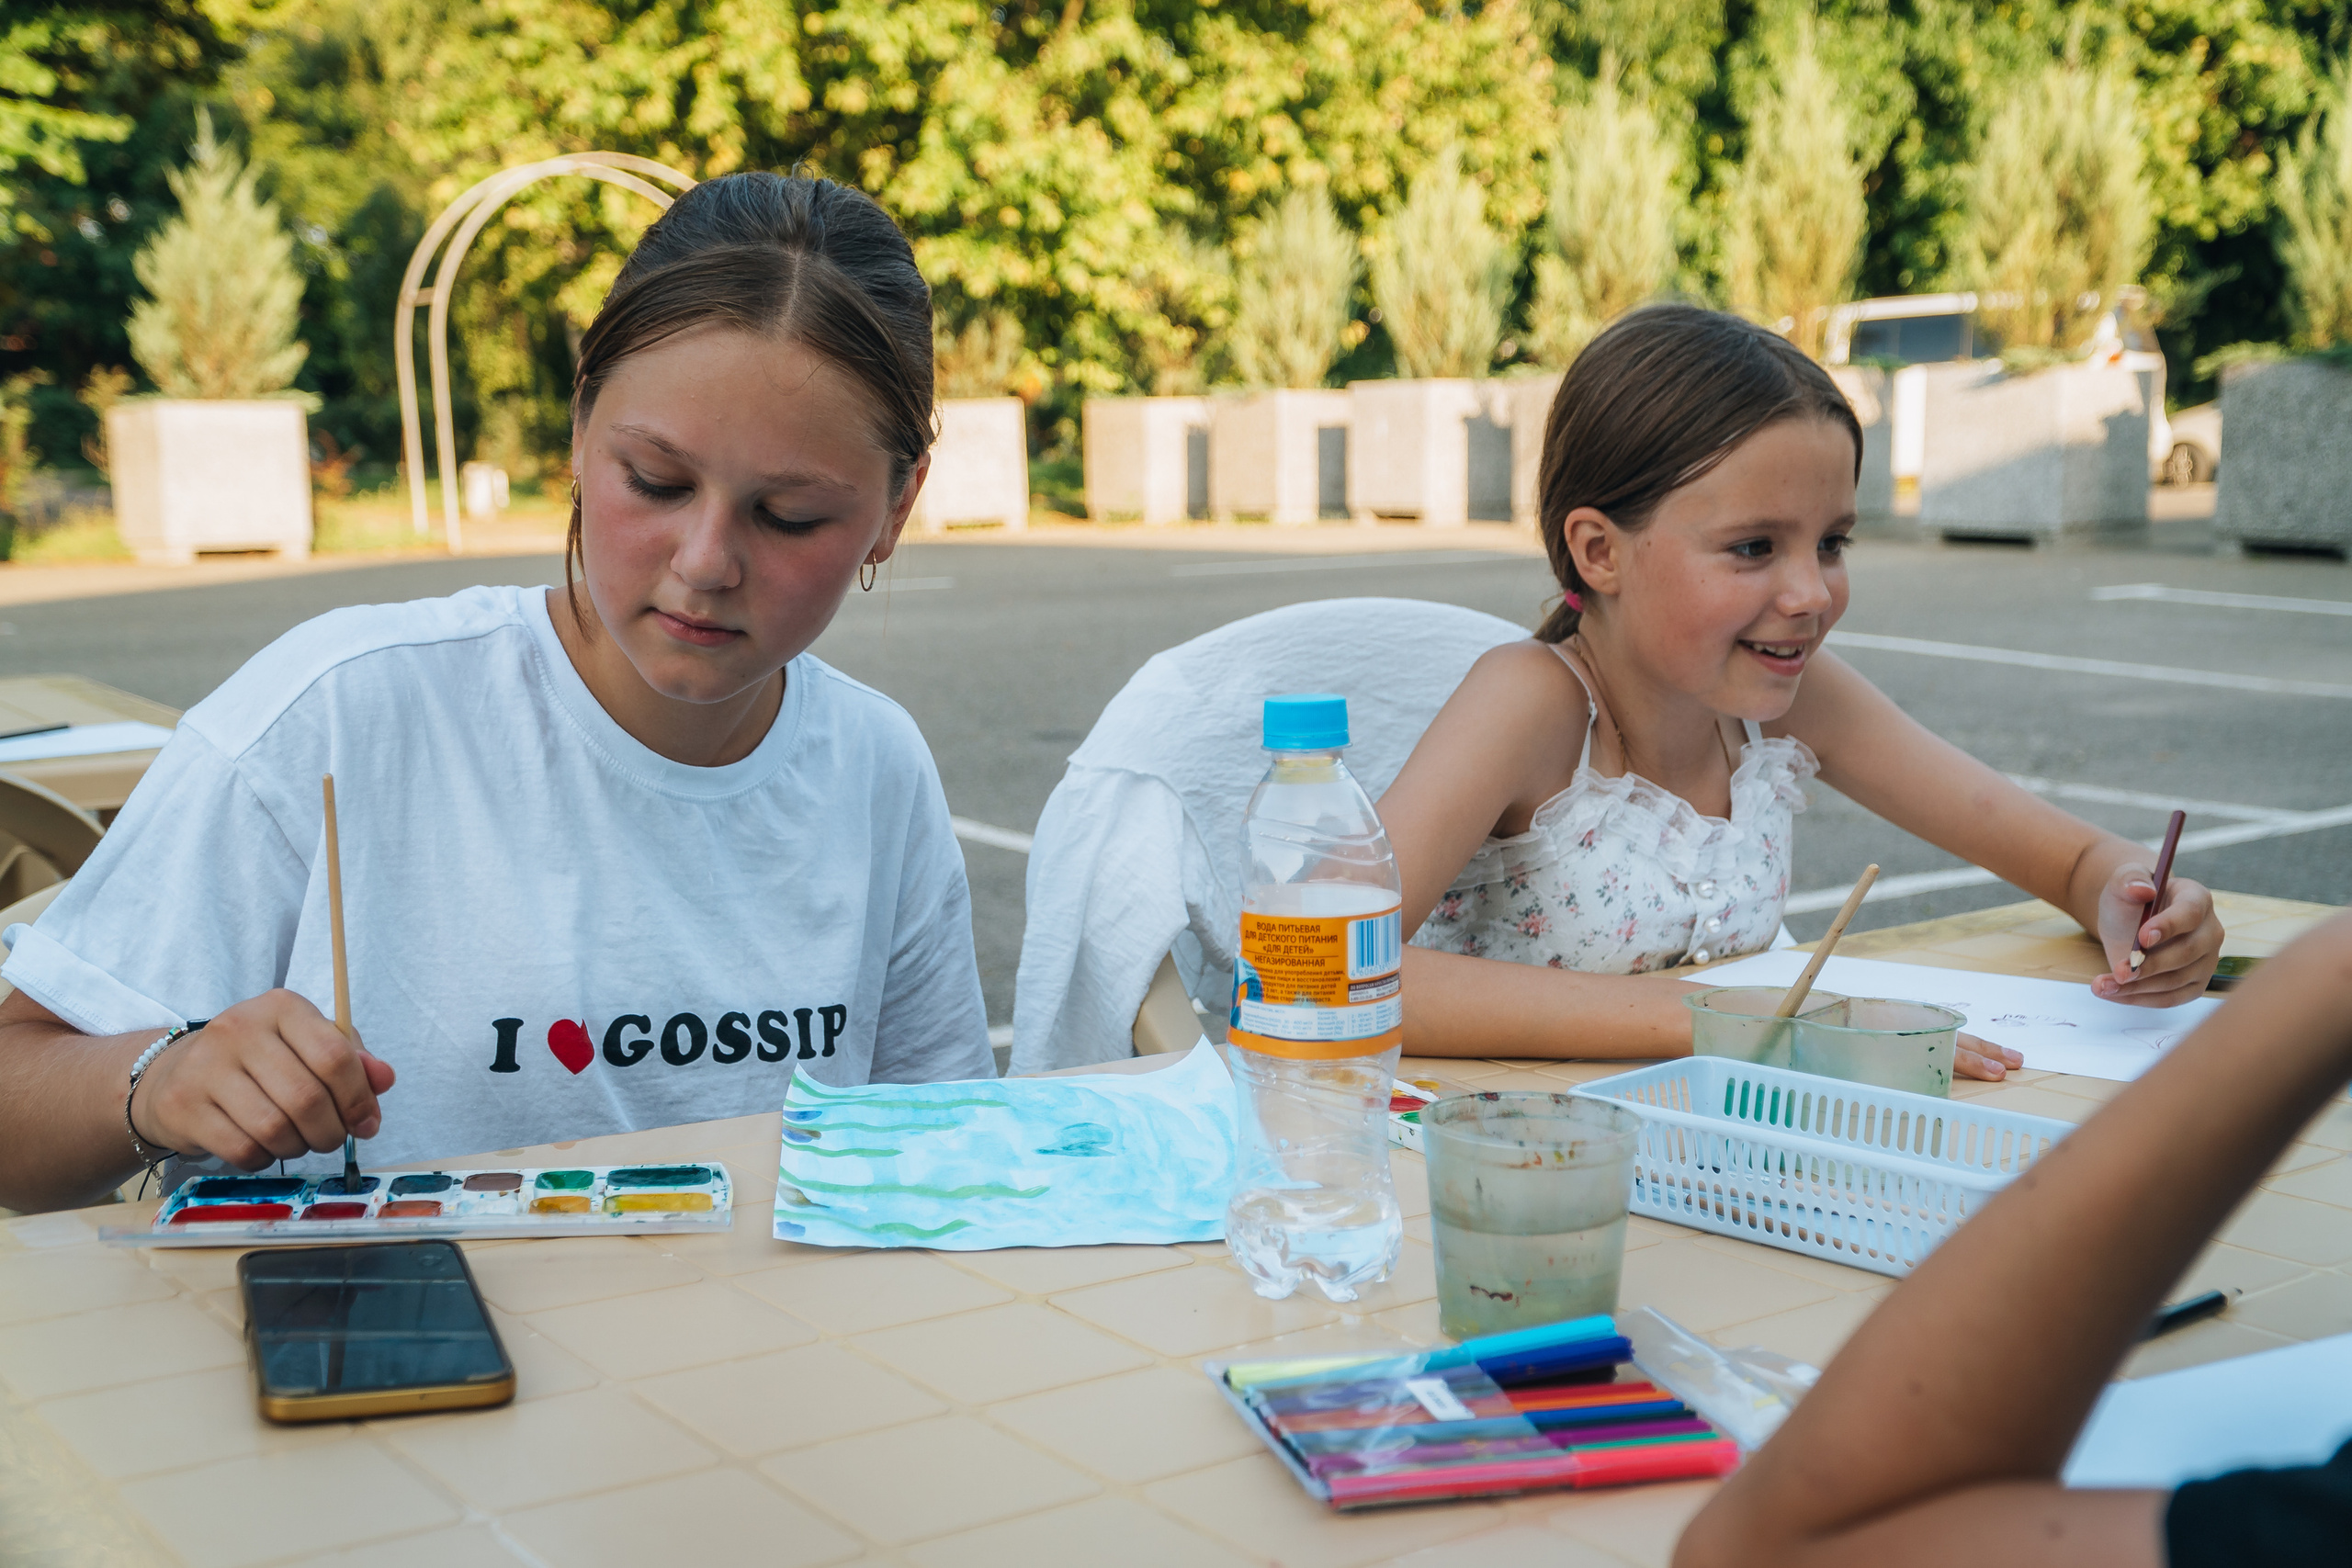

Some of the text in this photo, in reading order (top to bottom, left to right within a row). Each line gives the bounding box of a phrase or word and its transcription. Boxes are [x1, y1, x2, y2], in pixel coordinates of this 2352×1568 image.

[1256, 921, 1321, 933] ВОДА ПИТЬЕВАЯ
[1245, 930, 1338, 943] ДЛЯ ДЕТСКОГО ПИТАНИЯ
[1262, 943, 1314, 955] «ДЛЯ ДЕТЕЙ»
[1254, 955, 1325, 967] НЕГАЗИРОВАННАЯ
[489, 1004, 847, 1073] I GOSSIP
